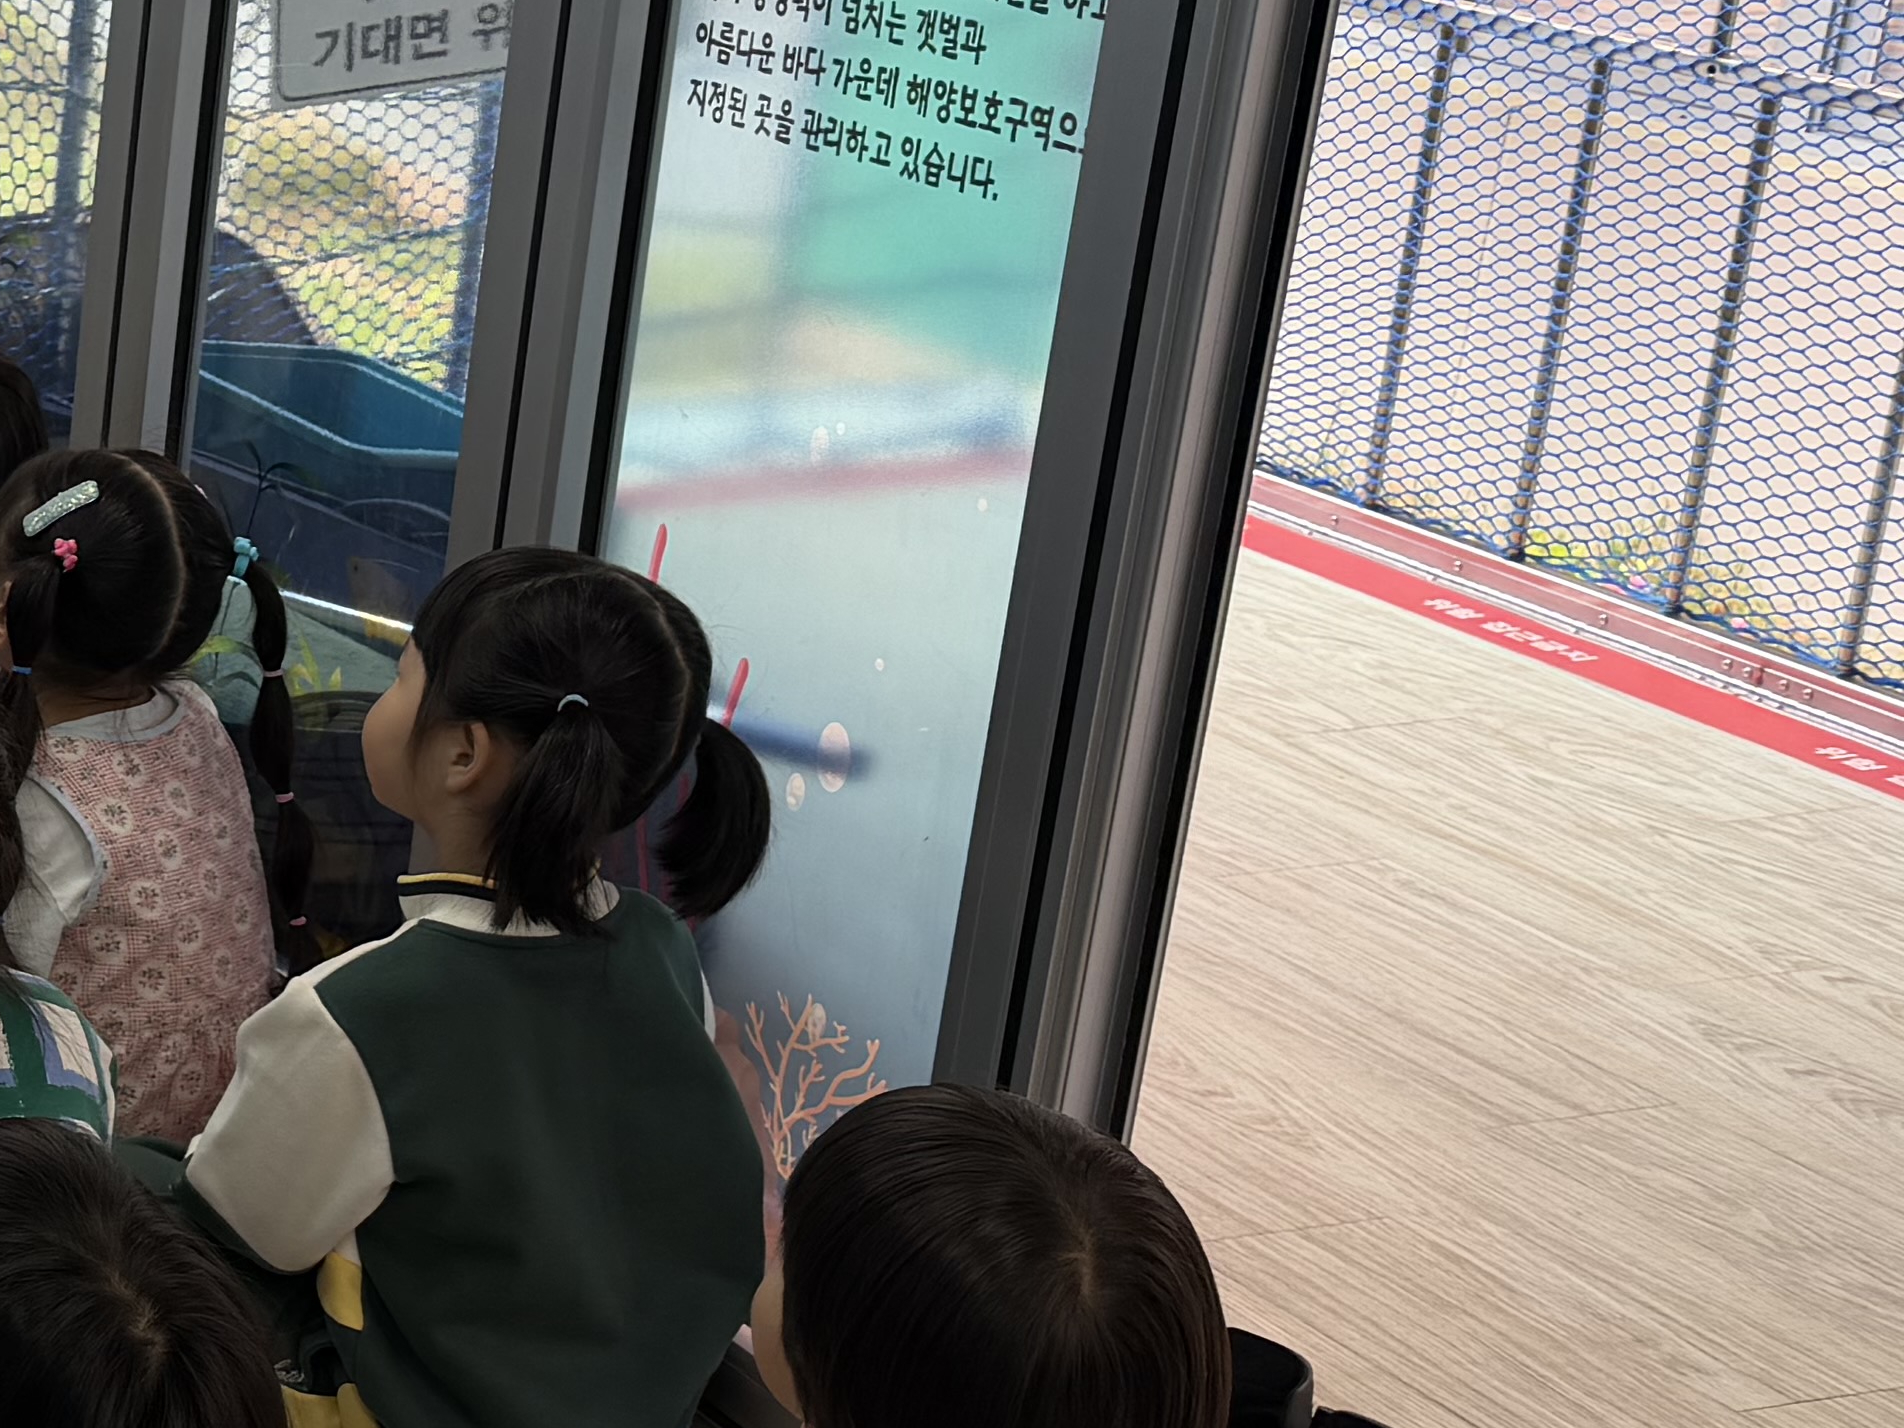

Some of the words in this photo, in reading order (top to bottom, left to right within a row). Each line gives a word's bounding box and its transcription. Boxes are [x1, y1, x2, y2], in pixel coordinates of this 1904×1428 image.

[313, 9, 450, 72] 기대면
[695, 18, 776, 75] 아름다운
[782, 43, 827, 87] 바다
[832, 57, 901, 110] 가운데
[916, 7, 987, 66] 갯벌과
[687, 77, 747, 130] 지정된
[754, 93, 795, 146] 곳을
[800, 107, 894, 168] 관리하고
[899, 136, 999, 202] 있습니다.
